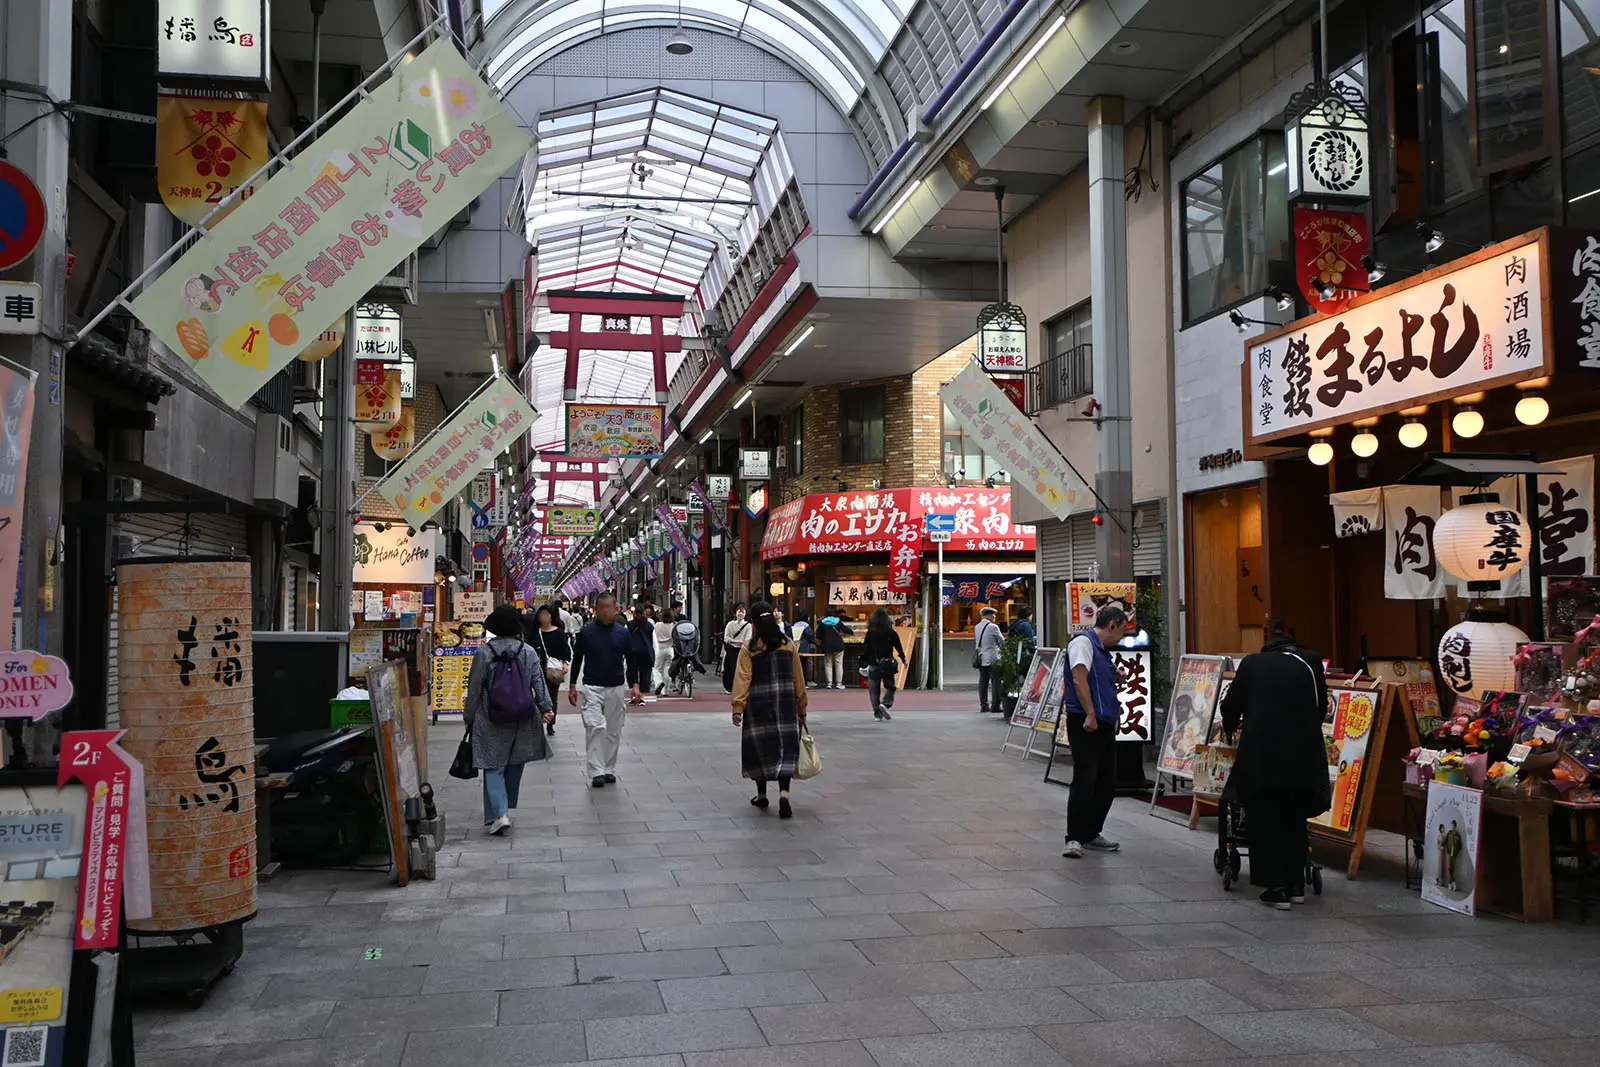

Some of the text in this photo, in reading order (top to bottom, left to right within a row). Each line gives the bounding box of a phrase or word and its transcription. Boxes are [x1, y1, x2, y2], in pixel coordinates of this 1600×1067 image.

[1324, 139, 1342, 182] まるよし
[1504, 255, 1532, 360] 肉酒場
[356, 339, 398, 354] 小林ビル
[1315, 282, 1481, 409] まるよし
[986, 354, 1023, 367] 天神橋2
[1257, 346, 1274, 427] 肉食堂
[820, 493, 895, 512] 大衆肉酒場
[801, 508, 907, 539] 肉のエサカ
[978, 539, 1024, 550] 肉のエサカ
[1483, 510, 1521, 571] 国産牛
[400, 546, 429, 566] Coffee
[893, 523, 918, 588] お弁当
[5, 661, 28, 673] For
[72, 742, 101, 765] 2F
